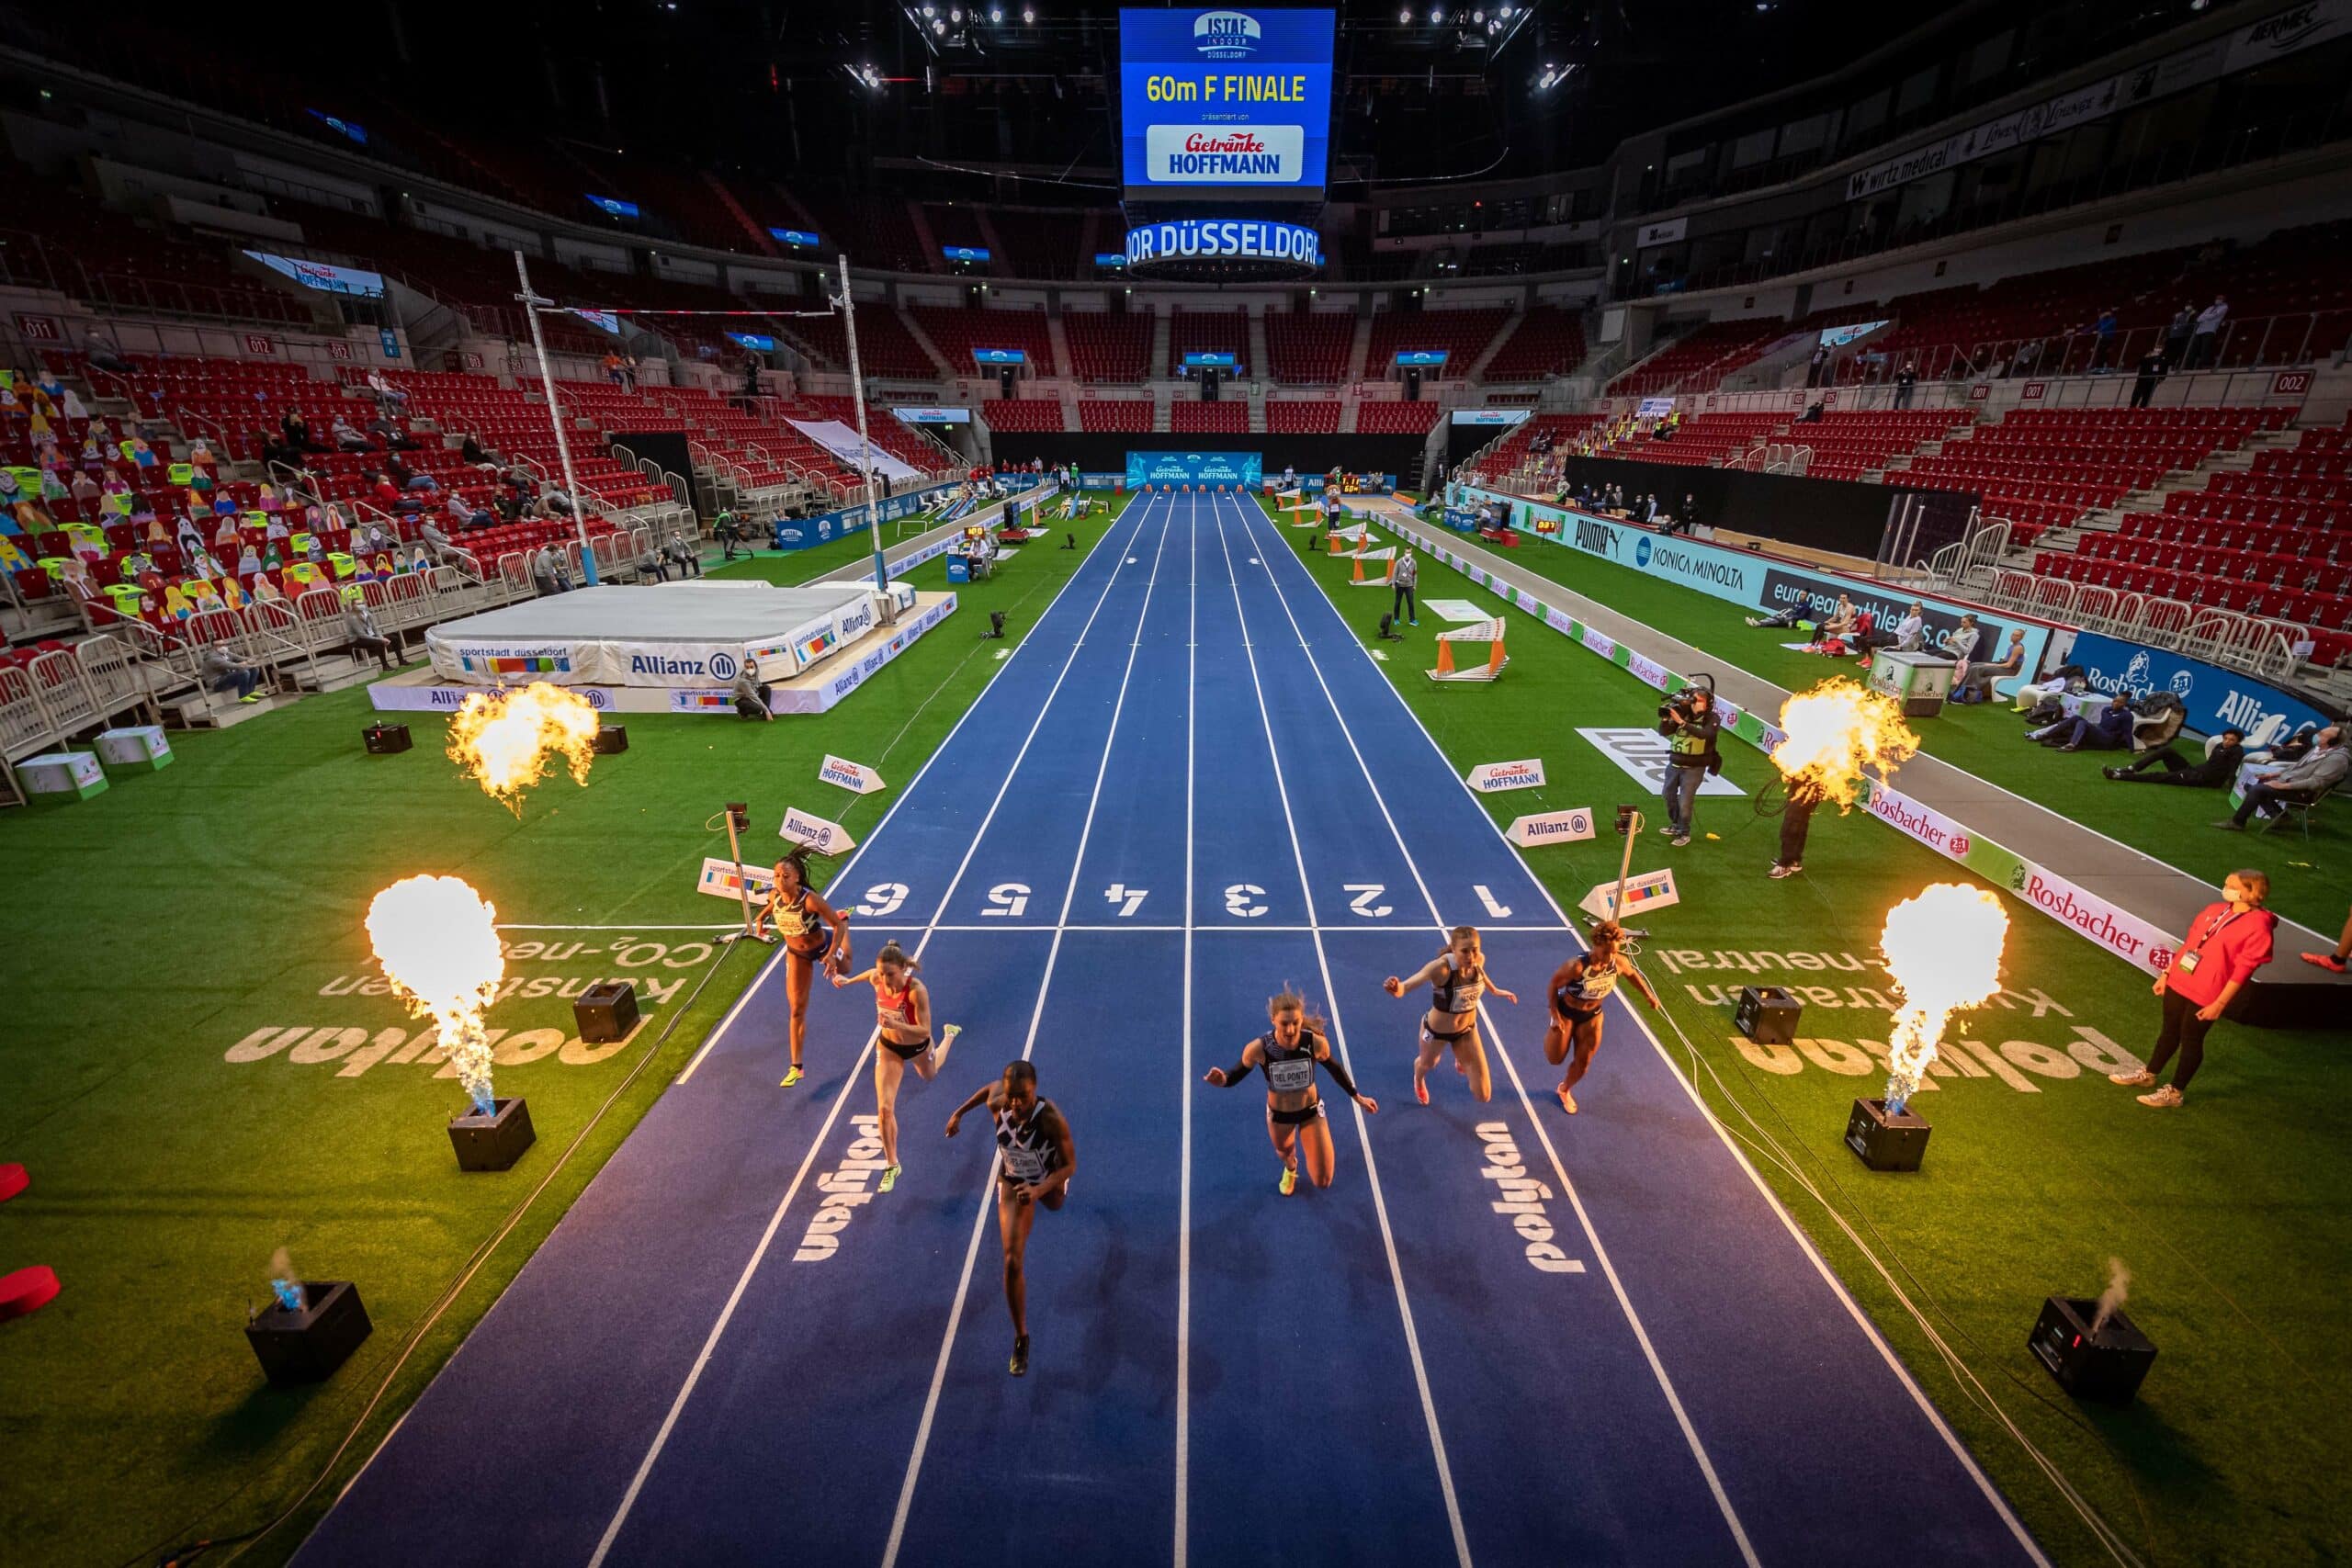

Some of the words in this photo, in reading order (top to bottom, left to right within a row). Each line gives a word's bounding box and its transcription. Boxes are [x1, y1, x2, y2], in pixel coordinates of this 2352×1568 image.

[1207, 18, 1247, 36] ISTAF
[2247, 4, 2318, 44] AERMEC
[1207, 51, 1246, 59] DÜSSELDORF
[1147, 75, 1197, 101] 60m
[1204, 75, 1217, 101] F
[1225, 75, 1306, 101] FINALE
[1202, 113, 1236, 121] präsentiert
[1185, 132, 1265, 152] Getränke
[1170, 154, 1280, 175] HOFFMANN
[1870, 165, 1899, 188] wirtz
[1901, 142, 1950, 177] medical
[1161, 220, 1318, 265] DÜSSELDORF
[27, 323, 52, 339] 011
[251, 340, 269, 354] 012
[1973, 387, 1986, 398] 001
[2026, 386, 2041, 397] 001
[2278, 377, 2304, 390] 002
[1575, 518, 1609, 555] PUMA
[1653, 546, 1691, 575] KONICA
[1692, 560, 1743, 591] MINOLTA
[459, 648, 510, 657] sportstadt
[514, 647, 567, 657] düsseldorf
[631, 655, 706, 675] Allianz
[1630, 657, 1660, 684] Rosbacher
[2087, 667, 2154, 701] Rosbac
[2173, 676, 2188, 689] 2:1
[431, 690, 466, 705] Allia
[2215, 690, 2291, 747] Alliaz
[822, 768, 864, 790] HOFFMANN
[831, 761, 860, 778] Getränke
[1489, 764, 1530, 778] Getränke
[1483, 773, 1541, 790] HOFFMANN
[786, 818, 818, 840] Allianz
[1527, 819, 1570, 837] Allianz
[1871, 788, 1947, 848] Rosbacher
[856, 883, 910, 917] 6
[981, 884, 1031, 917] 5
[1104, 884, 1148, 917] 4
[1225, 884, 1267, 917] 3
[1343, 884, 1393, 917] 2
[1473, 885, 1512, 918] 1
[2027, 874, 2143, 956] Rosbacher
[1274, 1073, 1287, 1082] DEL
[1287, 1071, 1308, 1081] PONTE
[1475, 1122, 1587, 1273] polytan
